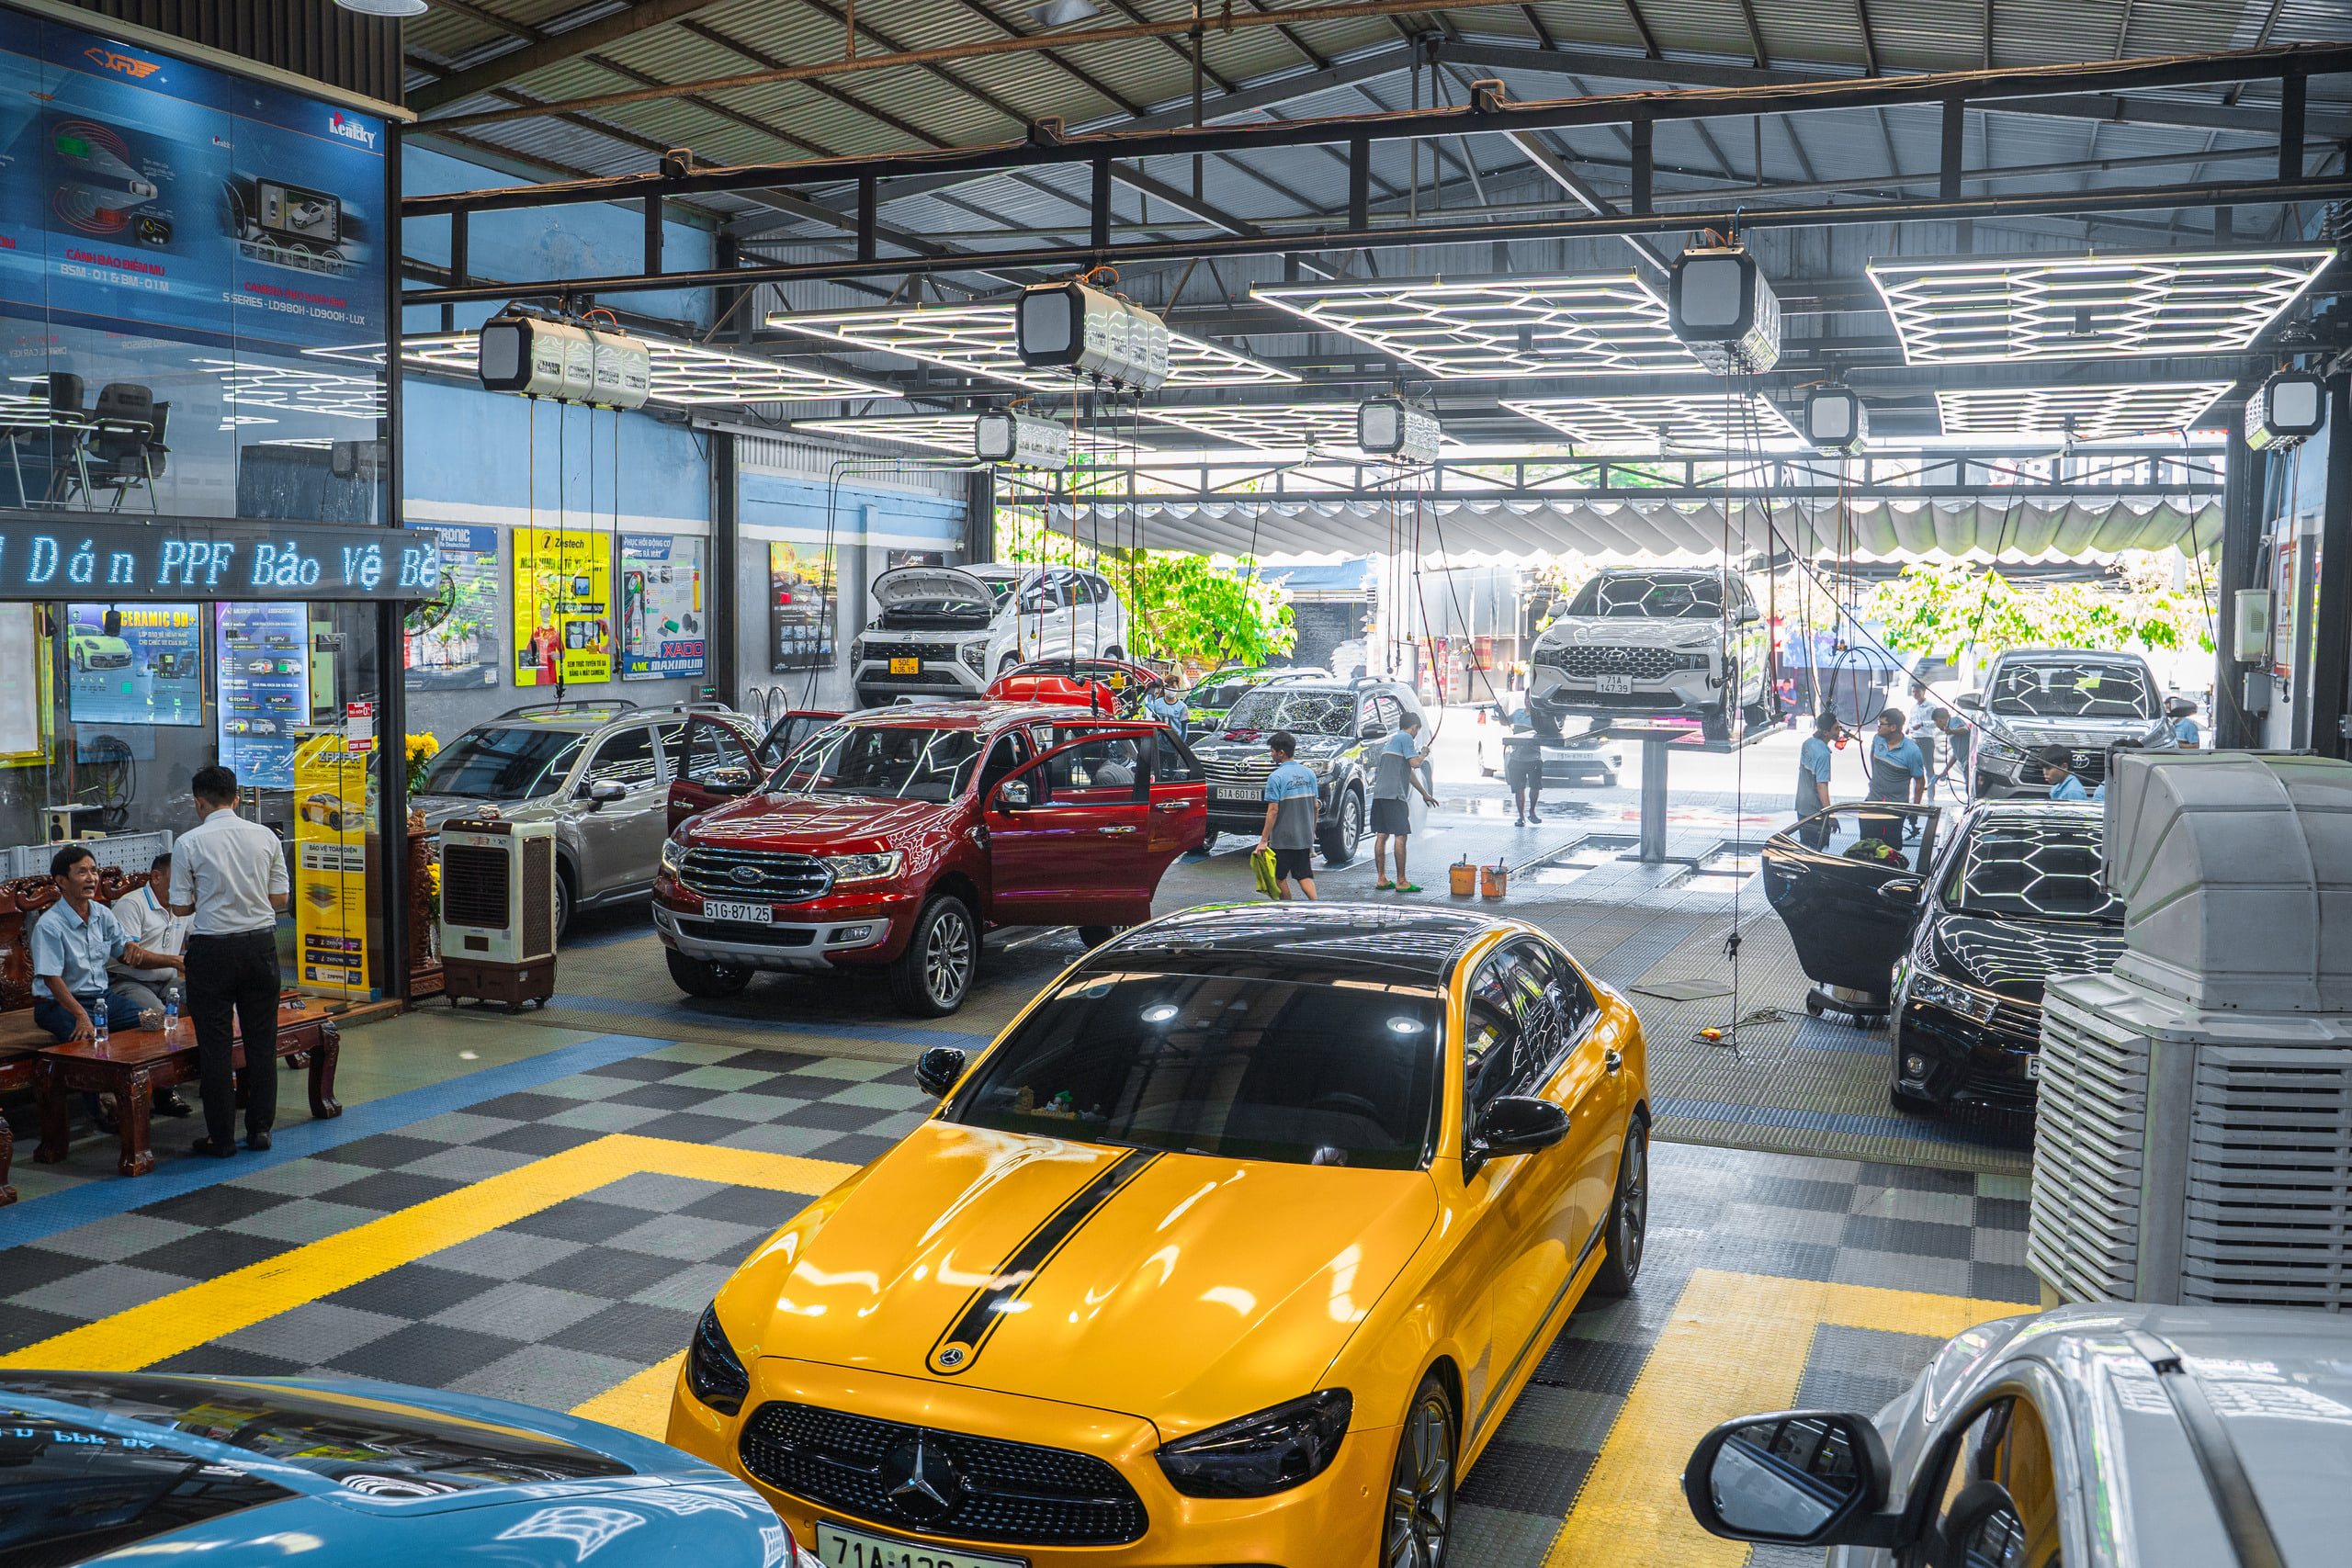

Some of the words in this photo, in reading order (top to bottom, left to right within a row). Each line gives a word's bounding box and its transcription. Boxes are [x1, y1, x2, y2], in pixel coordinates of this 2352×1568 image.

[60, 263, 86, 277] BSM
[110, 272, 120, 284] &
[244, 281, 283, 298] CAMERA
[231, 293, 264, 309] SERIES
[349, 313, 366, 325] LUX
[157, 541, 234, 584] PPF
[251, 541, 321, 587] Bảo
[343, 544, 382, 591] Vệ
[120, 610, 170, 627] CERAMIC
[663, 642, 704, 658] XADO
[631, 661, 649, 671] AMC
[650, 659, 704, 671] MAXIMUM
[1600, 683, 1628, 693] 147.39
[1607, 676, 1622, 684] 71A
[705, 902, 770, 922] 51G-871.25
